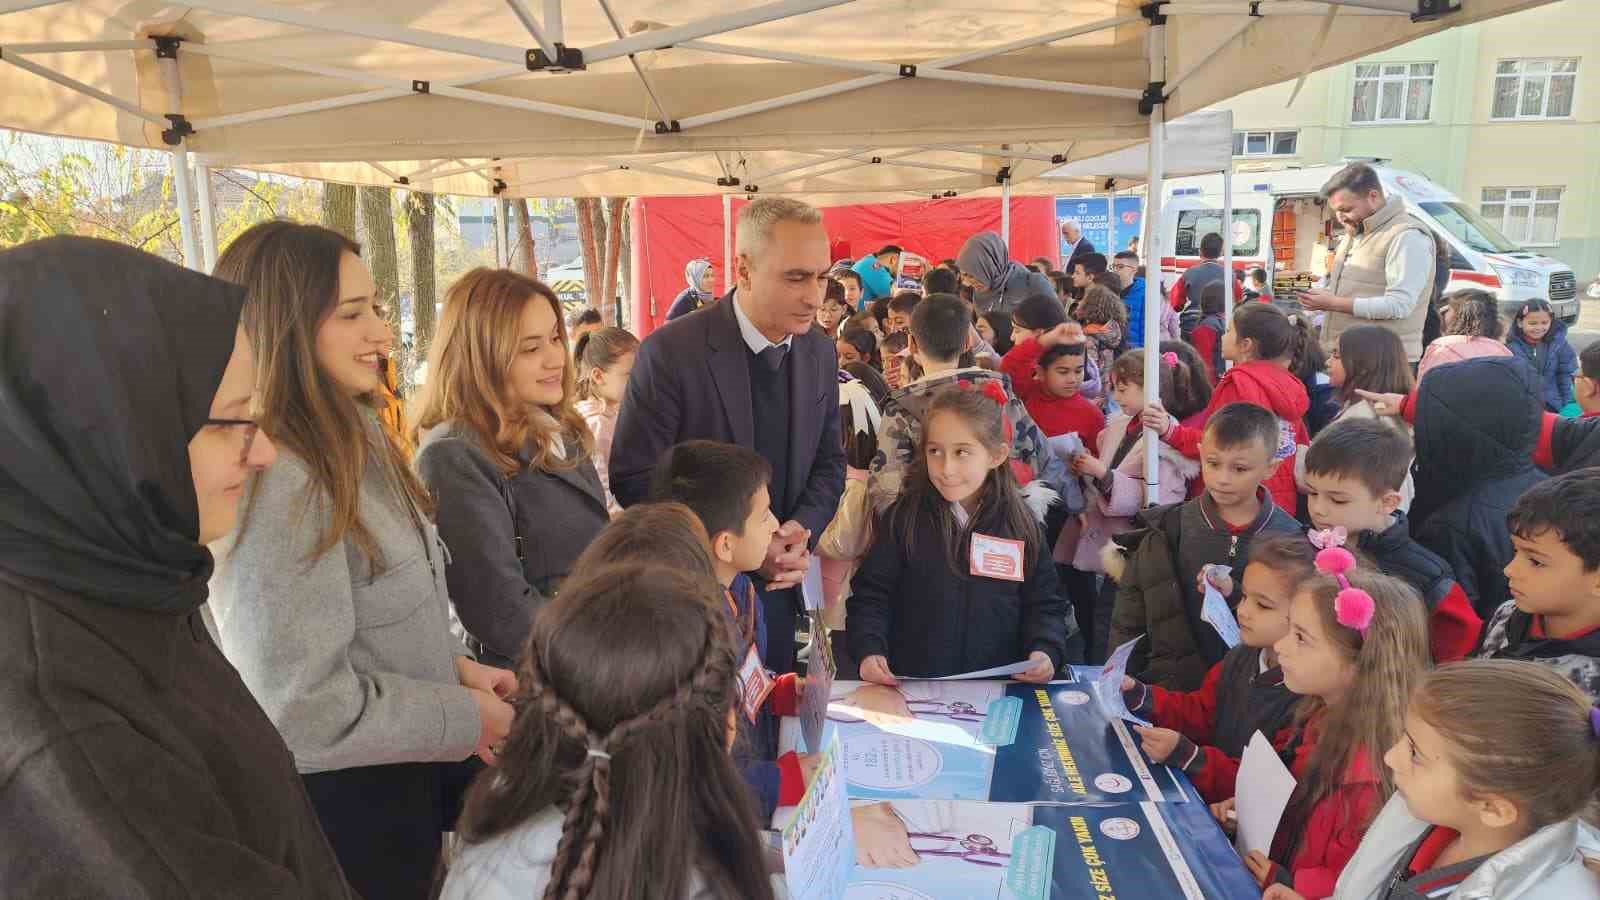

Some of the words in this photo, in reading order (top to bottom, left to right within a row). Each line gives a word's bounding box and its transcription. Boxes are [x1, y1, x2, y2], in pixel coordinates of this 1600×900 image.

[1047, 721, 1065, 738] SİZE
[1069, 816, 1094, 845] YAKIN
[1080, 846, 1106, 866] ÇOK
[1089, 868, 1113, 893] SİZE
